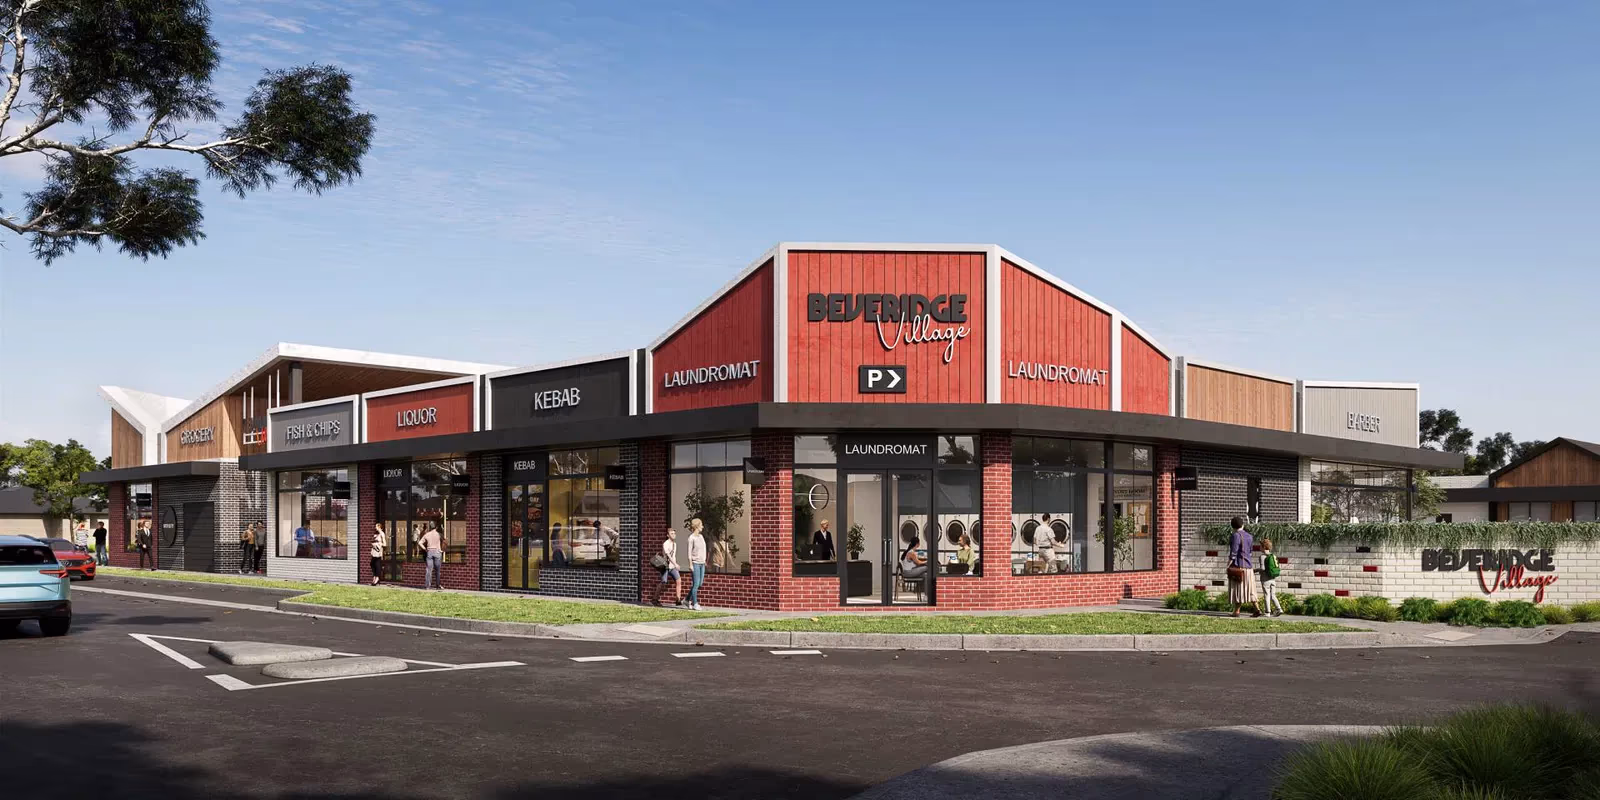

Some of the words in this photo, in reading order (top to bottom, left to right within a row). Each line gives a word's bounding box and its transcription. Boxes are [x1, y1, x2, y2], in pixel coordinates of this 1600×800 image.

[807, 293, 967, 322] BEVERIDGE
[876, 312, 971, 363] Village
[664, 360, 760, 388] LAUNDROMAT
[867, 369, 882, 388] P
[1008, 361, 1108, 386] LAUNDROMAT
[534, 387, 581, 410] KEBAB
[397, 407, 437, 427] LIQUOR
[1347, 411, 1381, 433] BARBER
[180, 426, 215, 445] GROCERY
[287, 425, 304, 440] FISH
[306, 423, 313, 438] &
[315, 420, 340, 436] CHIPS
[845, 443, 928, 455] LAUNDROMAT
[383, 468, 403, 478] LIQUOR
[514, 460, 535, 471] KEBAB
[1478, 564, 1558, 603] Village
